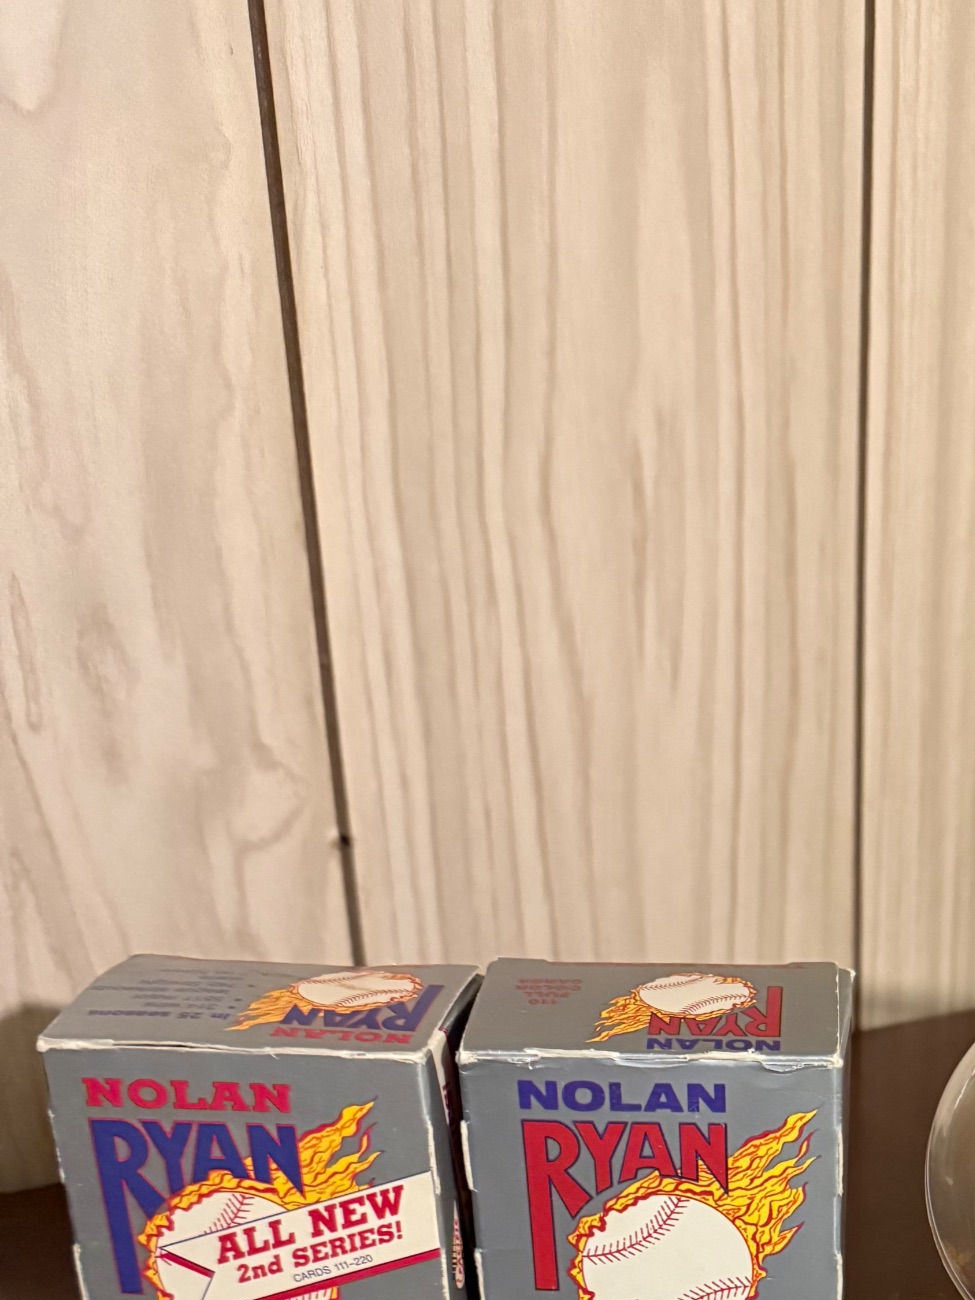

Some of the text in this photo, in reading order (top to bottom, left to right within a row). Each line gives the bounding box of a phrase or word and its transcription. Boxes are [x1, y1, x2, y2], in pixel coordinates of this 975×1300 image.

[279, 985, 444, 1032] RYAN
[647, 983, 784, 1038] RYAN
[270, 1027, 415, 1045] NOLAN
[646, 1038, 782, 1052] NOLAN
[82, 1077, 292, 1113] NOLAN
[517, 1079, 727, 1113] NOLAN
[88, 1117, 307, 1295] RYAN
[217, 1184, 404, 1265] ALL NEW
[521, 1119, 729, 1291] RYAN
[236, 1220, 404, 1284] 2nd SERIES!
[293, 1264, 332, 1283] CARDS
